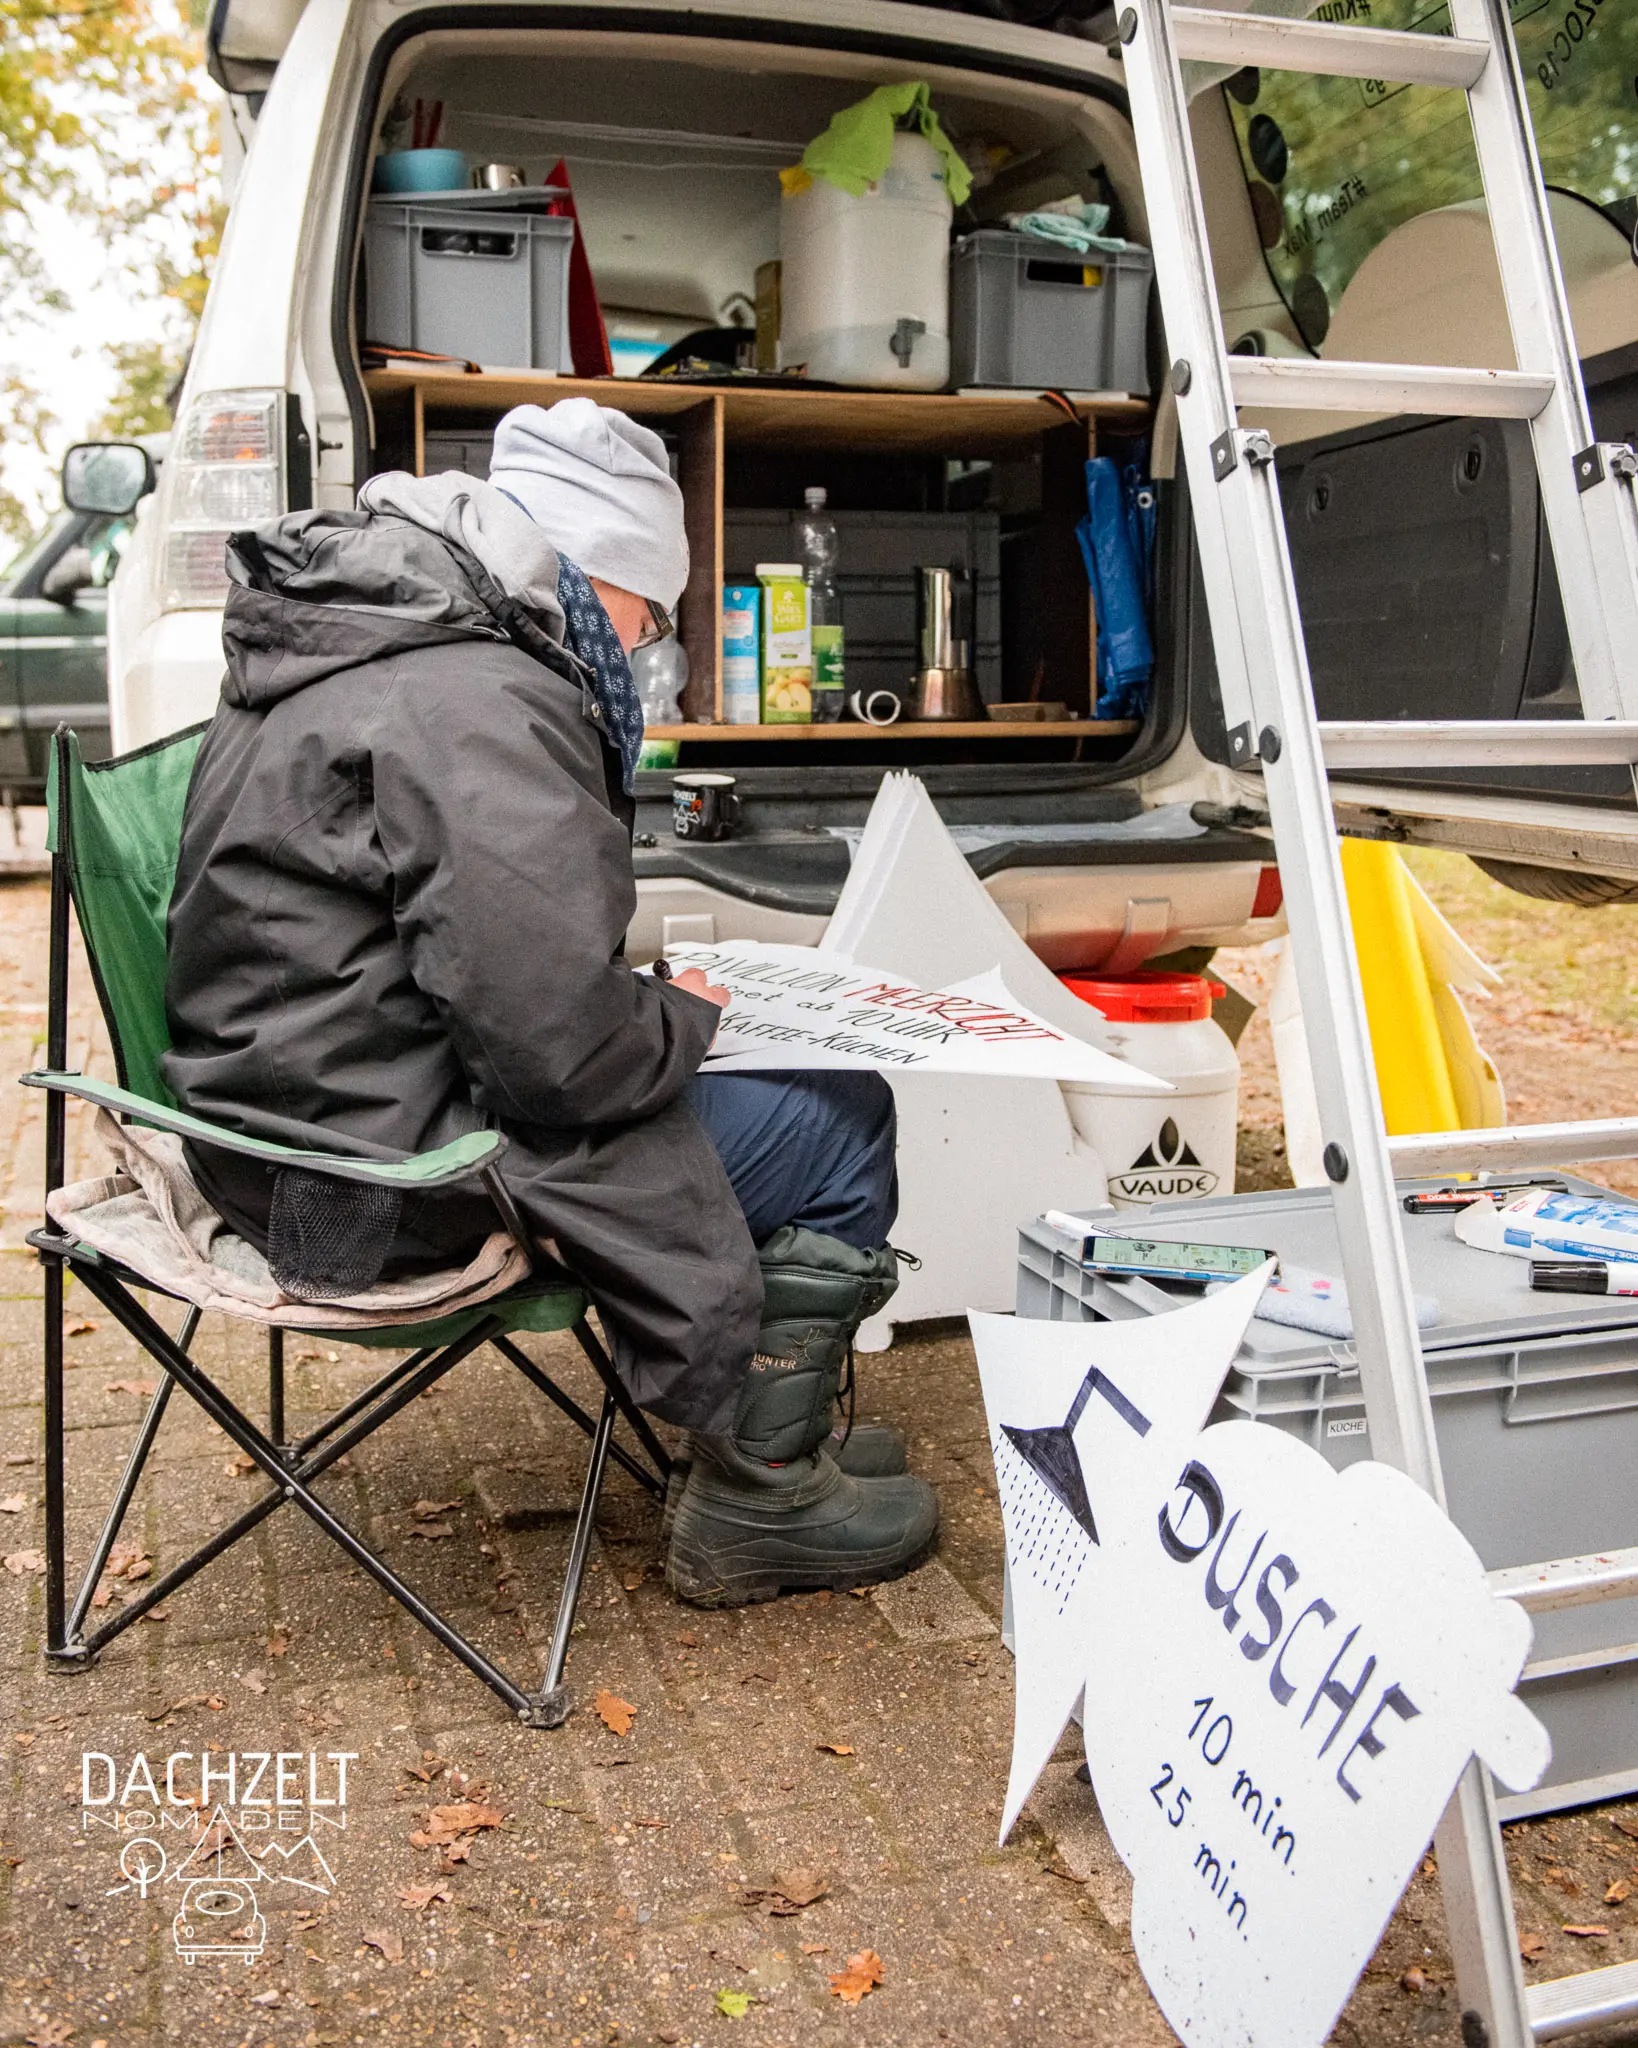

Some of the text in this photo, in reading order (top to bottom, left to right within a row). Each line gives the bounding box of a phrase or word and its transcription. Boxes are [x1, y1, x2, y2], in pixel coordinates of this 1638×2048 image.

[667, 952, 1064, 1042] PAVILLION MEERZICHT
[797, 1001, 835, 1012] ab
[837, 1009, 895, 1027] 10
[882, 1018, 969, 1044] UHR
[1120, 1176, 1207, 1195] VAUDE
[1158, 1460, 1421, 1804] DUSCHE
[1188, 1697, 1233, 1766] 10
[1150, 1763, 1192, 1827] 25
